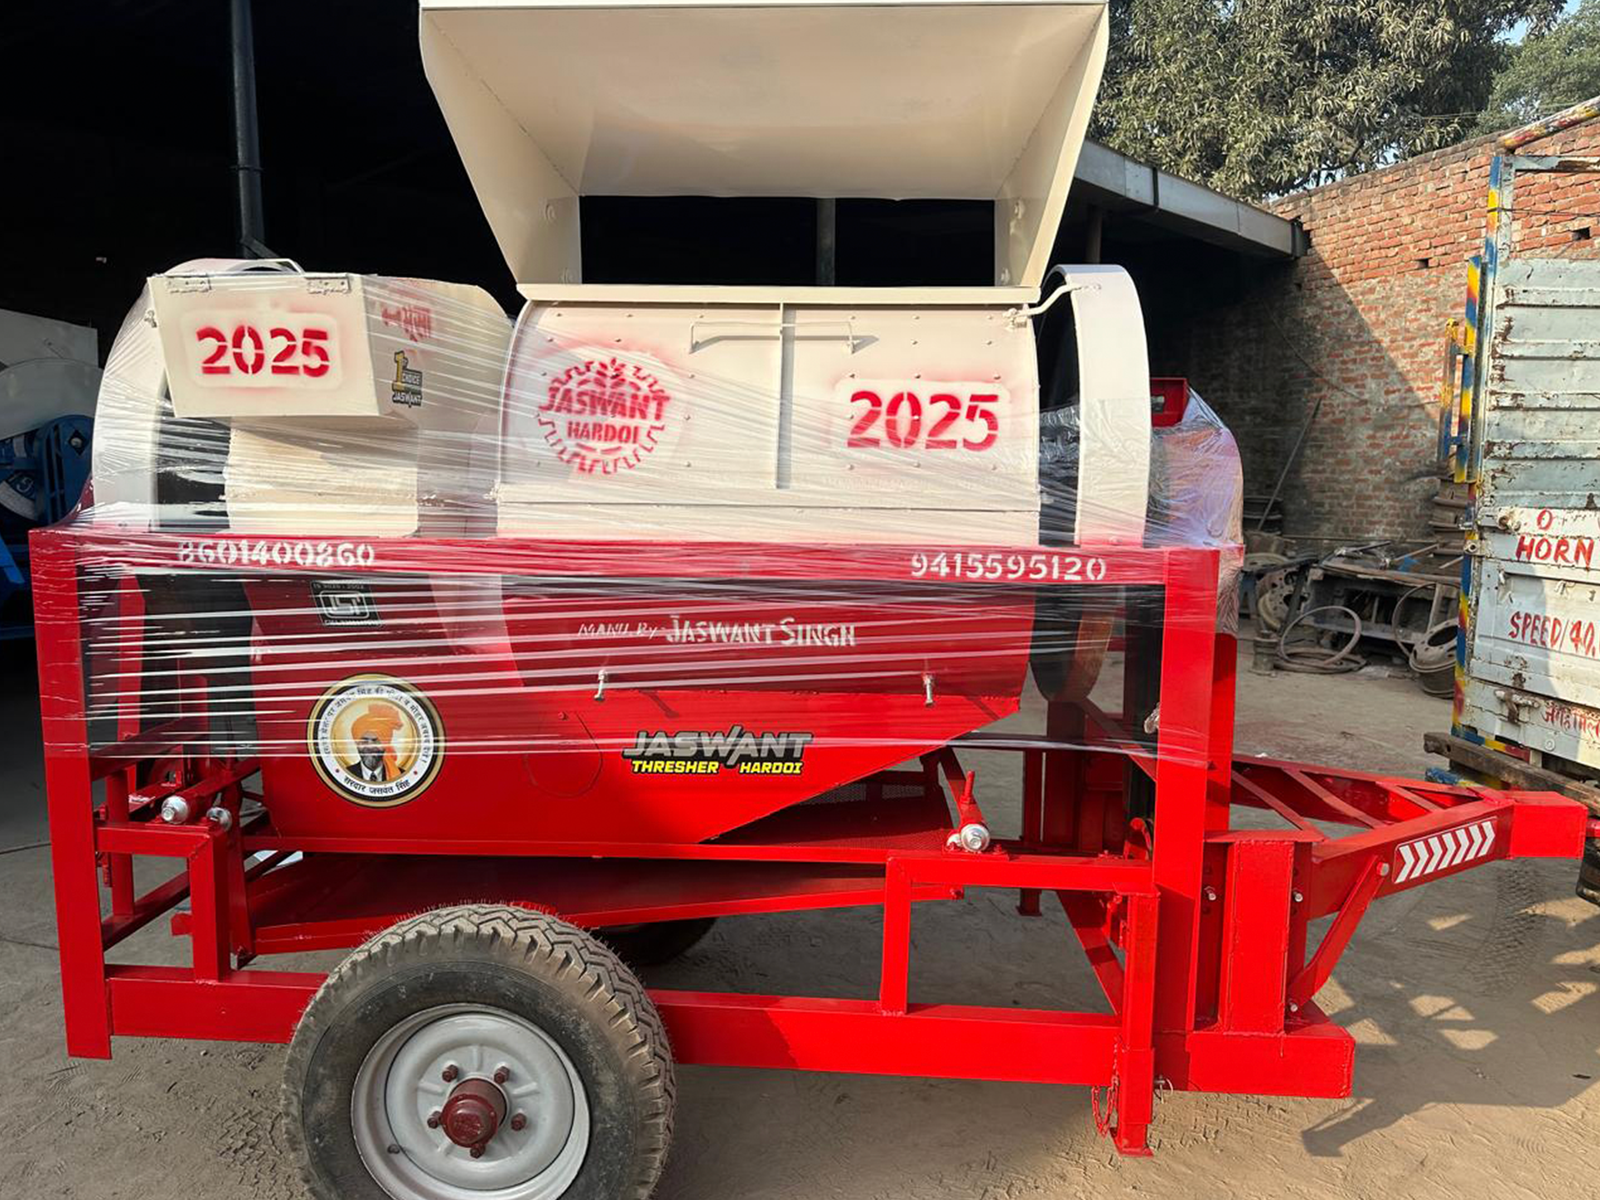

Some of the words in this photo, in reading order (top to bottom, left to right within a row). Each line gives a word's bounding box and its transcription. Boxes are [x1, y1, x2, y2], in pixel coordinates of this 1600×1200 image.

[196, 325, 330, 378] 2025
[392, 392, 421, 406] JASWANT
[538, 386, 671, 421] JASWANT
[567, 421, 640, 444] HARDOI
[847, 390, 999, 452] 2025
[176, 539, 376, 567] 8601400860
[911, 552, 1107, 581] 9415595120
[1515, 535, 1595, 568] HORN
[665, 615, 776, 645] JASWANT
[779, 616, 857, 648] SINGH
[623, 725, 813, 766] JASWANT
[631, 760, 719, 774] THRESHER
[739, 761, 803, 775] HARDOI
